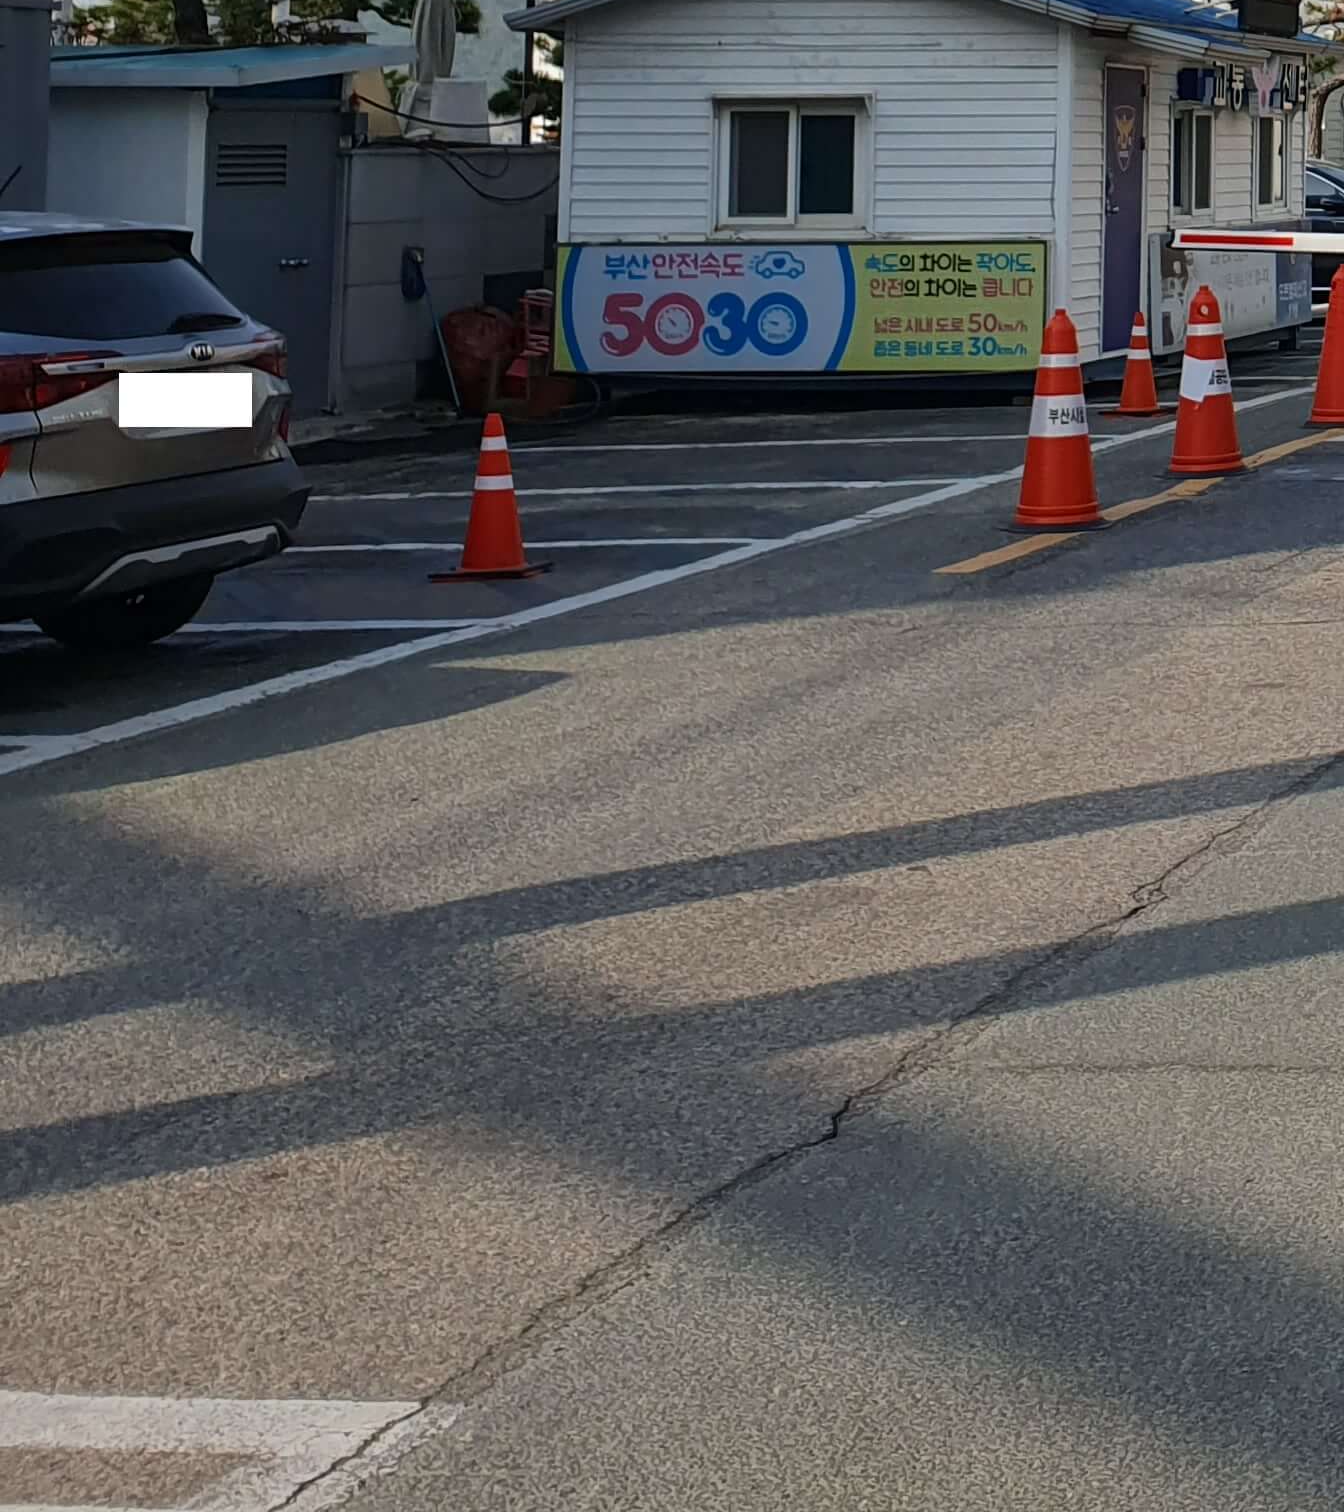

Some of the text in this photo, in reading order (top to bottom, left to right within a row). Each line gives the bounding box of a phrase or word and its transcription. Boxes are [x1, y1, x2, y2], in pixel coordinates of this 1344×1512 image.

[865, 253, 915, 273] 속도의
[919, 253, 973, 273] 차이는
[870, 278, 1034, 298] 안전의 차이는 큽니다
[601, 292, 809, 356] 5030
[874, 317, 902, 334] 넓은
[905, 317, 933, 334] 시내
[936, 317, 964, 334] 도로
[904, 340, 933, 358] 동네
[936, 340, 964, 357] 도로
